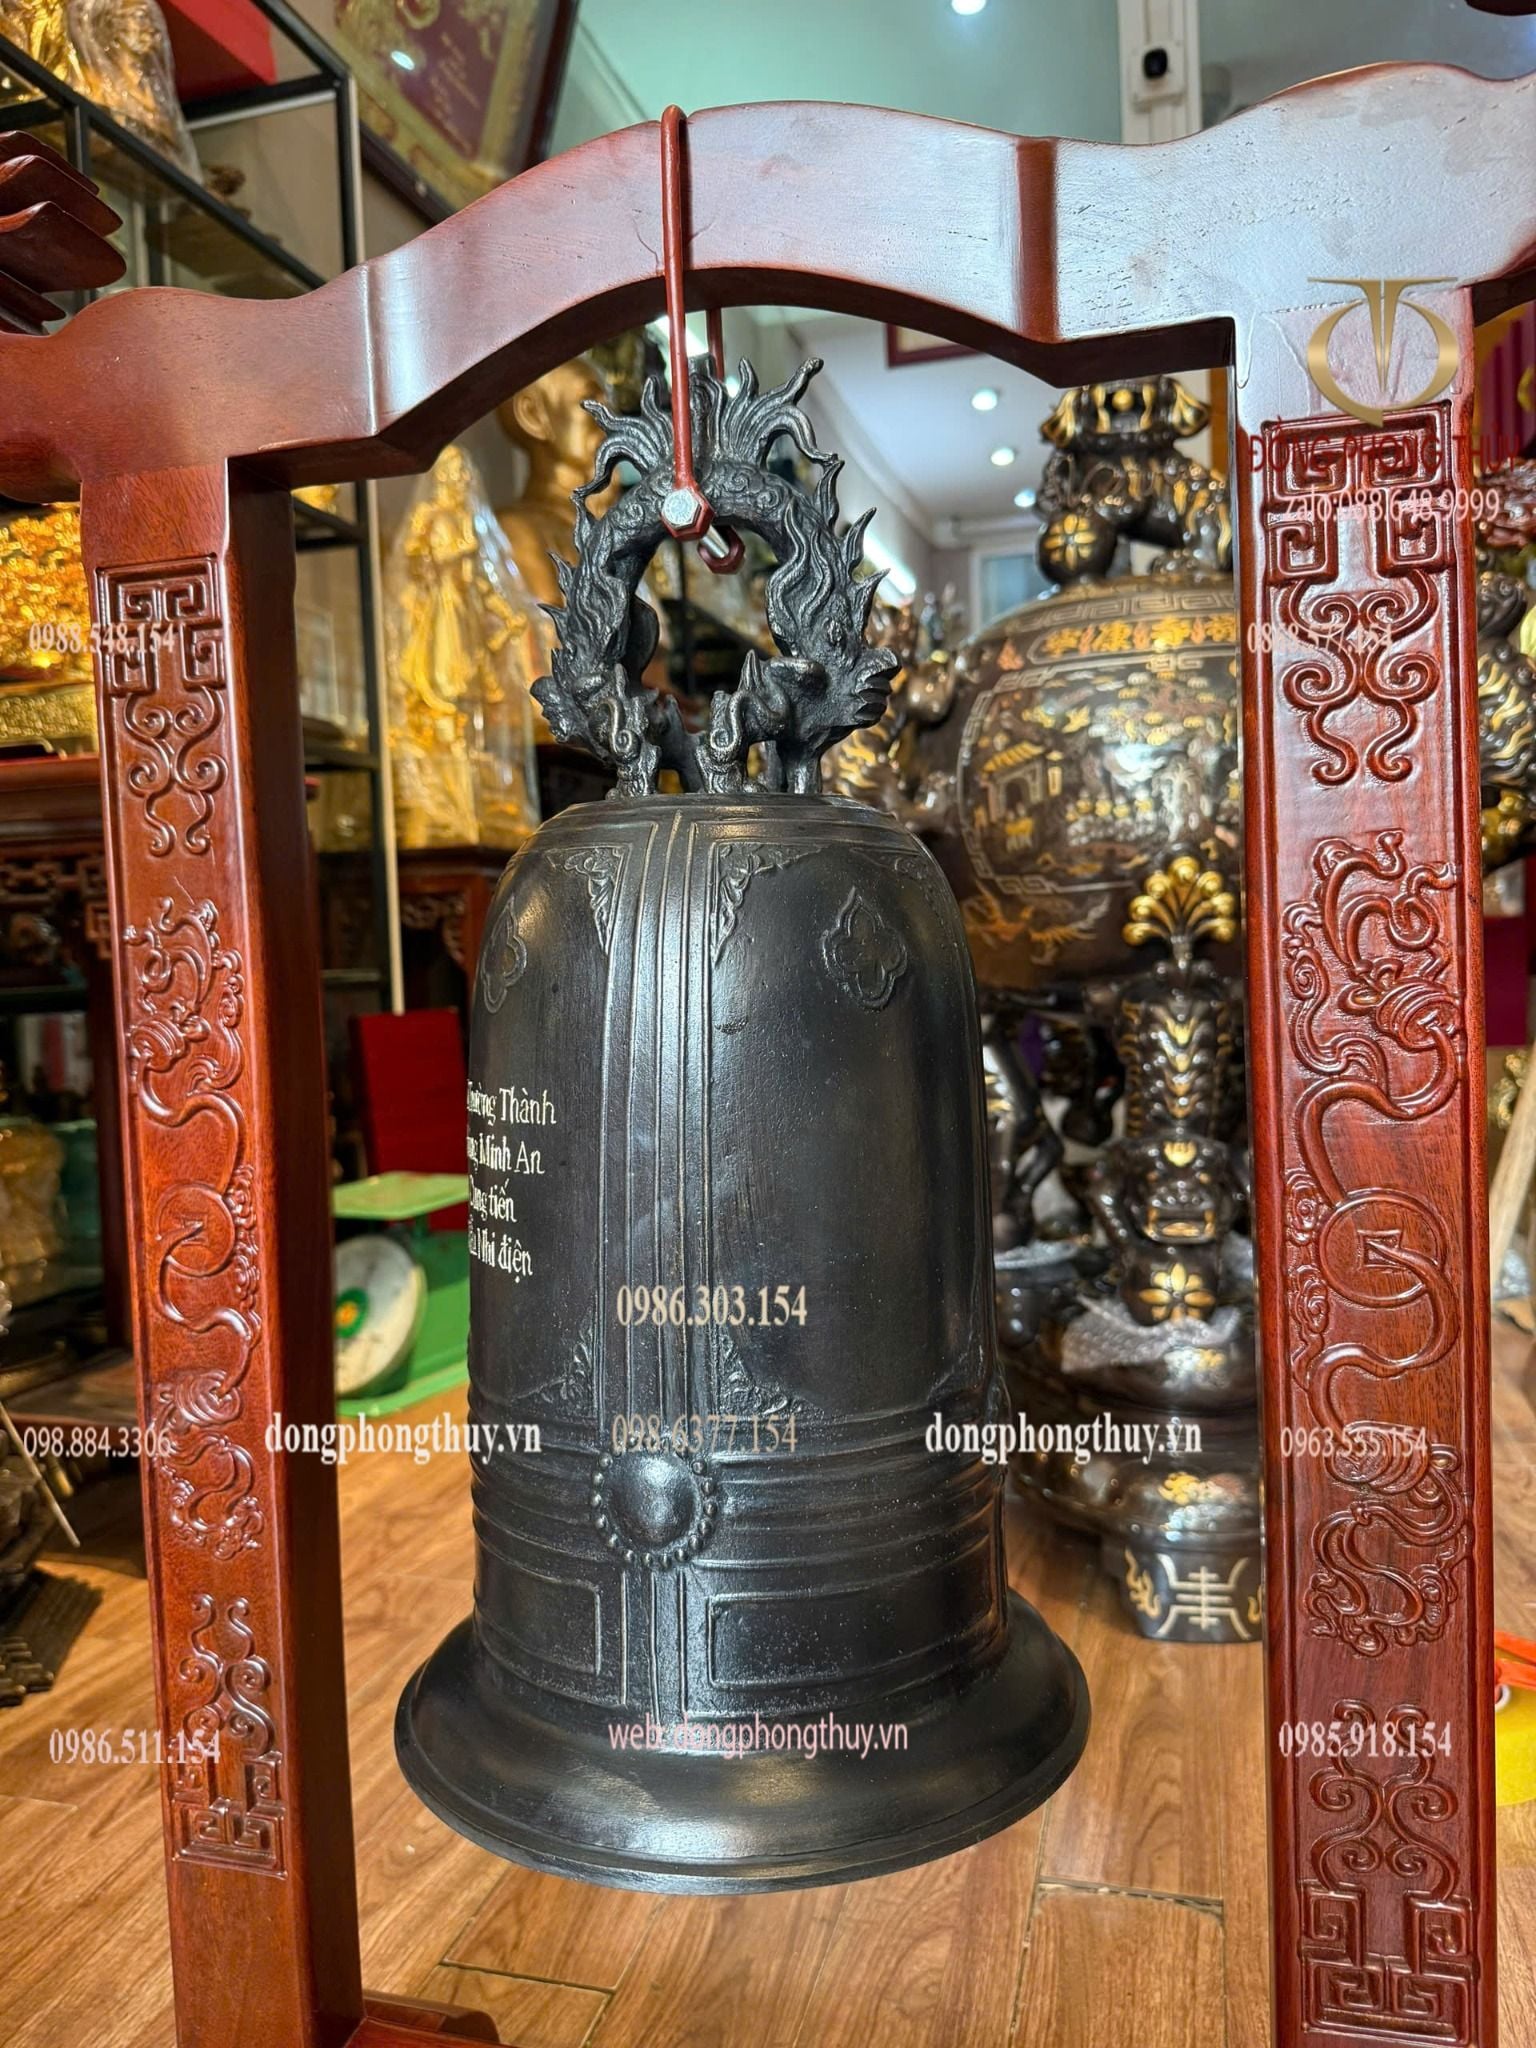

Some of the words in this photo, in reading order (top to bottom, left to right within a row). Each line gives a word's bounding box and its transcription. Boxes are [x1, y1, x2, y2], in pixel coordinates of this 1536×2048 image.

[499, 1085, 557, 1126] Thành
[514, 1140, 546, 1175] An
[488, 1178, 518, 1222] tiến
[497, 1233, 534, 1284] điện
